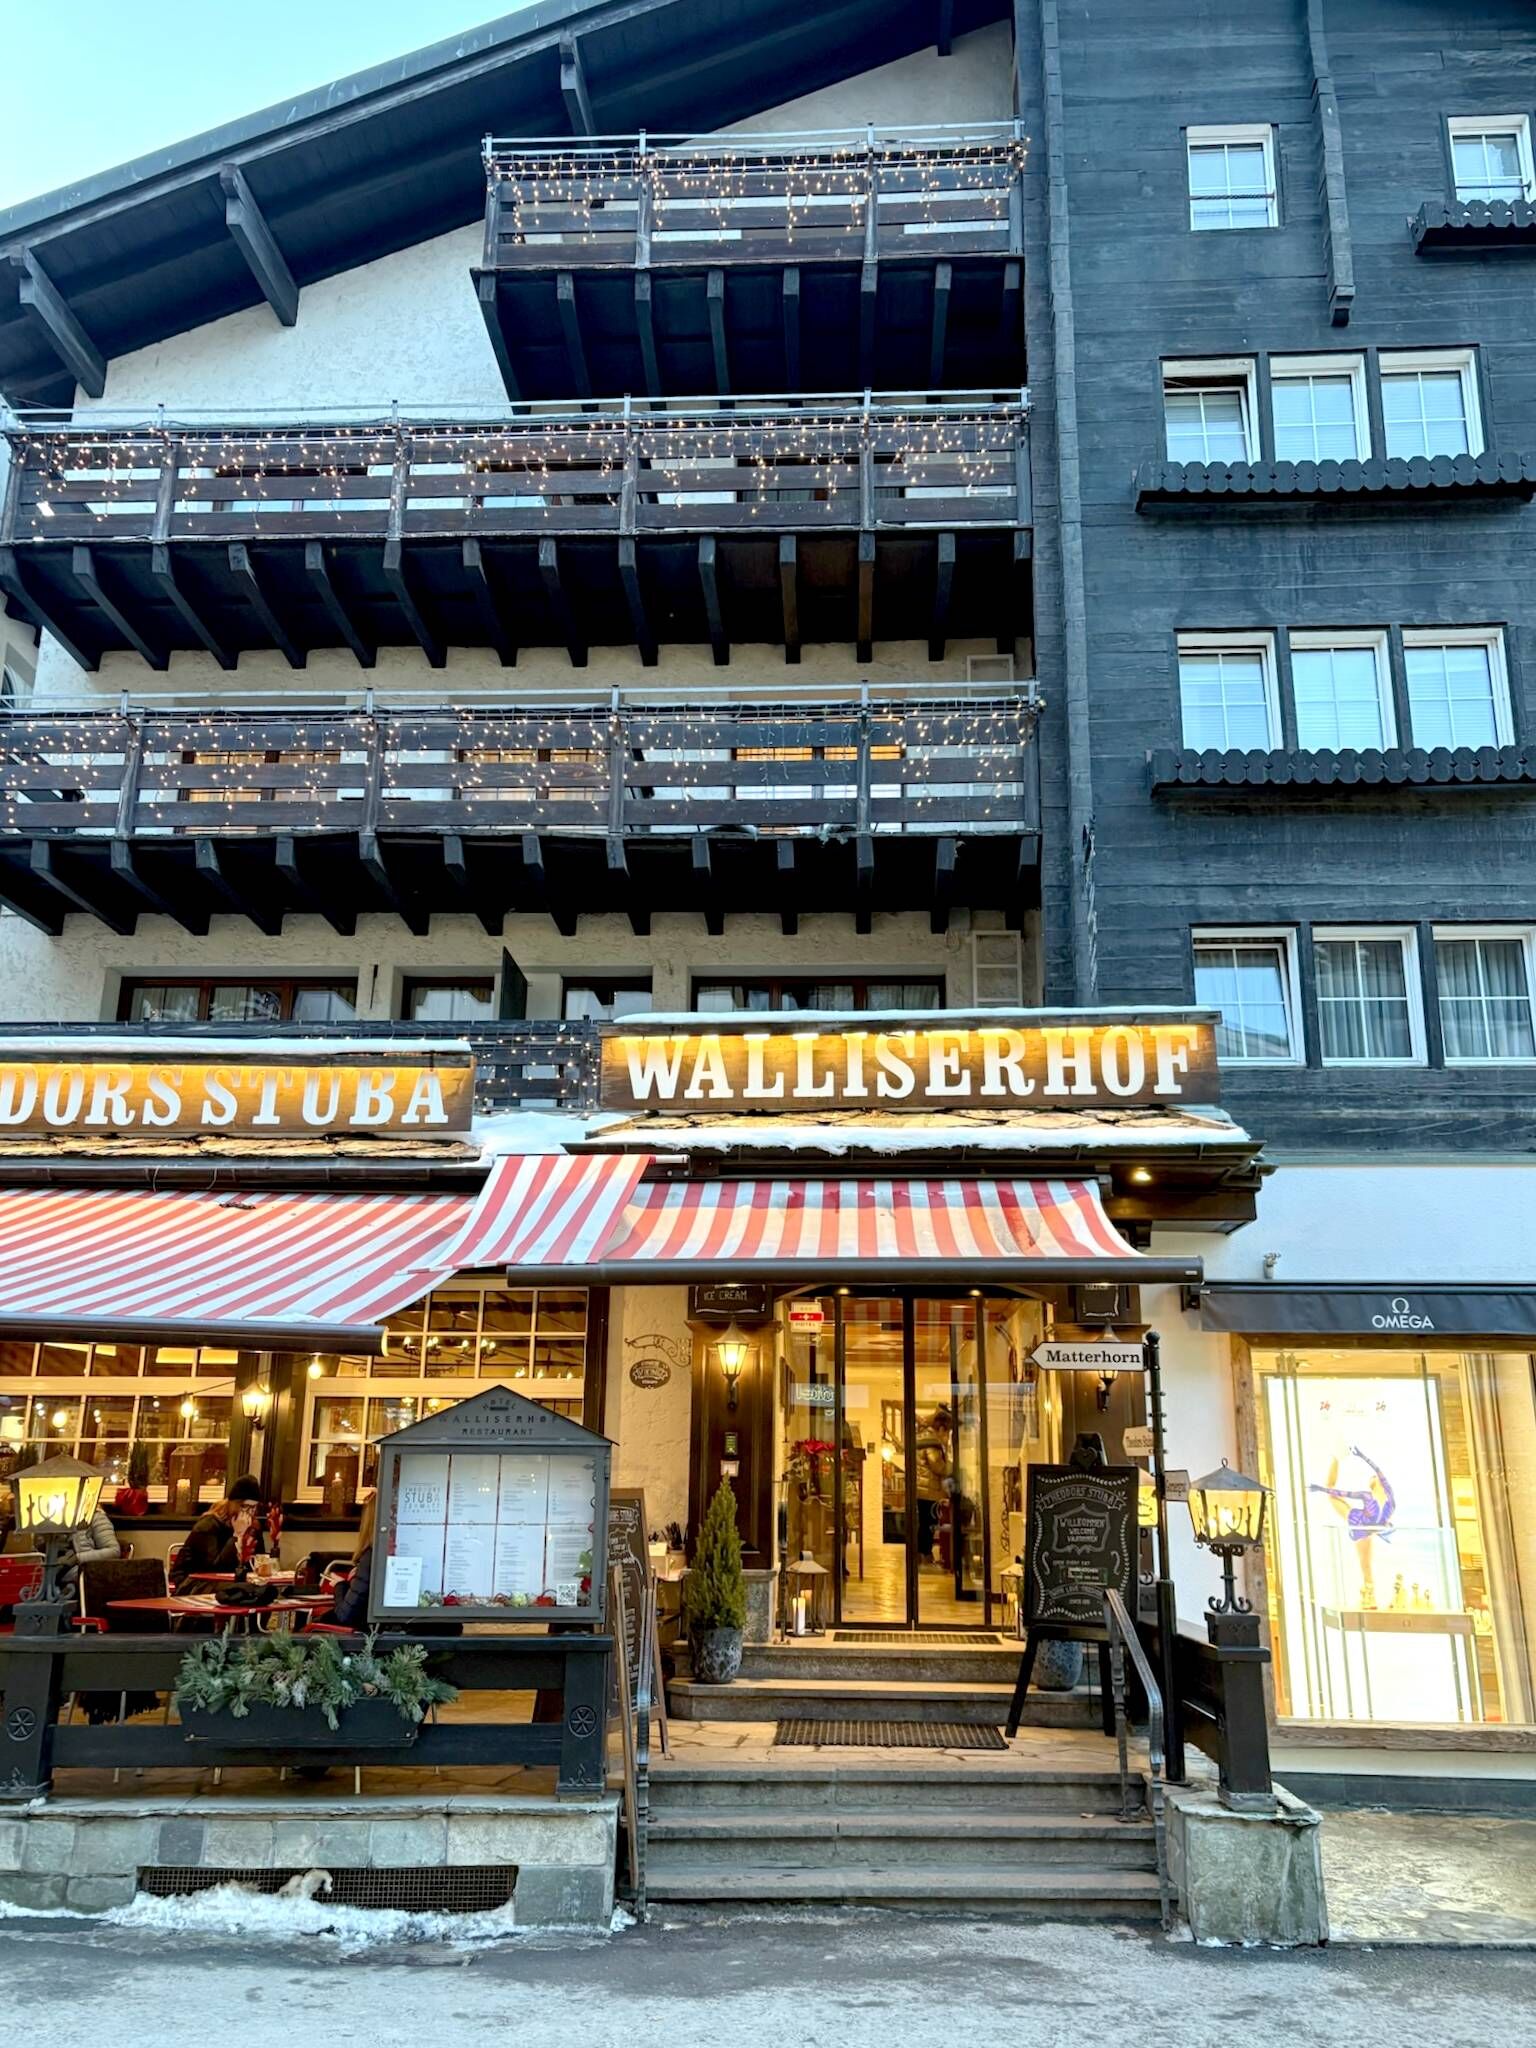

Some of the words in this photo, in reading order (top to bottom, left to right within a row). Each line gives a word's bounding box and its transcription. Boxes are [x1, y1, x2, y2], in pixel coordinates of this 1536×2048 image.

[620, 1025, 1198, 1100] WALLISERHOF
[0, 1064, 183, 1126] DORS
[201, 1066, 448, 1126] STUBA
[720, 1290, 747, 1300] CREAM
[1371, 1314, 1435, 1329] OMEGA
[1045, 1349, 1141, 1364] Matterhorn
[439, 1415, 557, 1424] WALLISERHOF
[462, 1428, 534, 1436] RESTAURANT
[405, 1492, 440, 1504] STUBA
[1059, 1517, 1106, 1528] WILLKOMMEN
